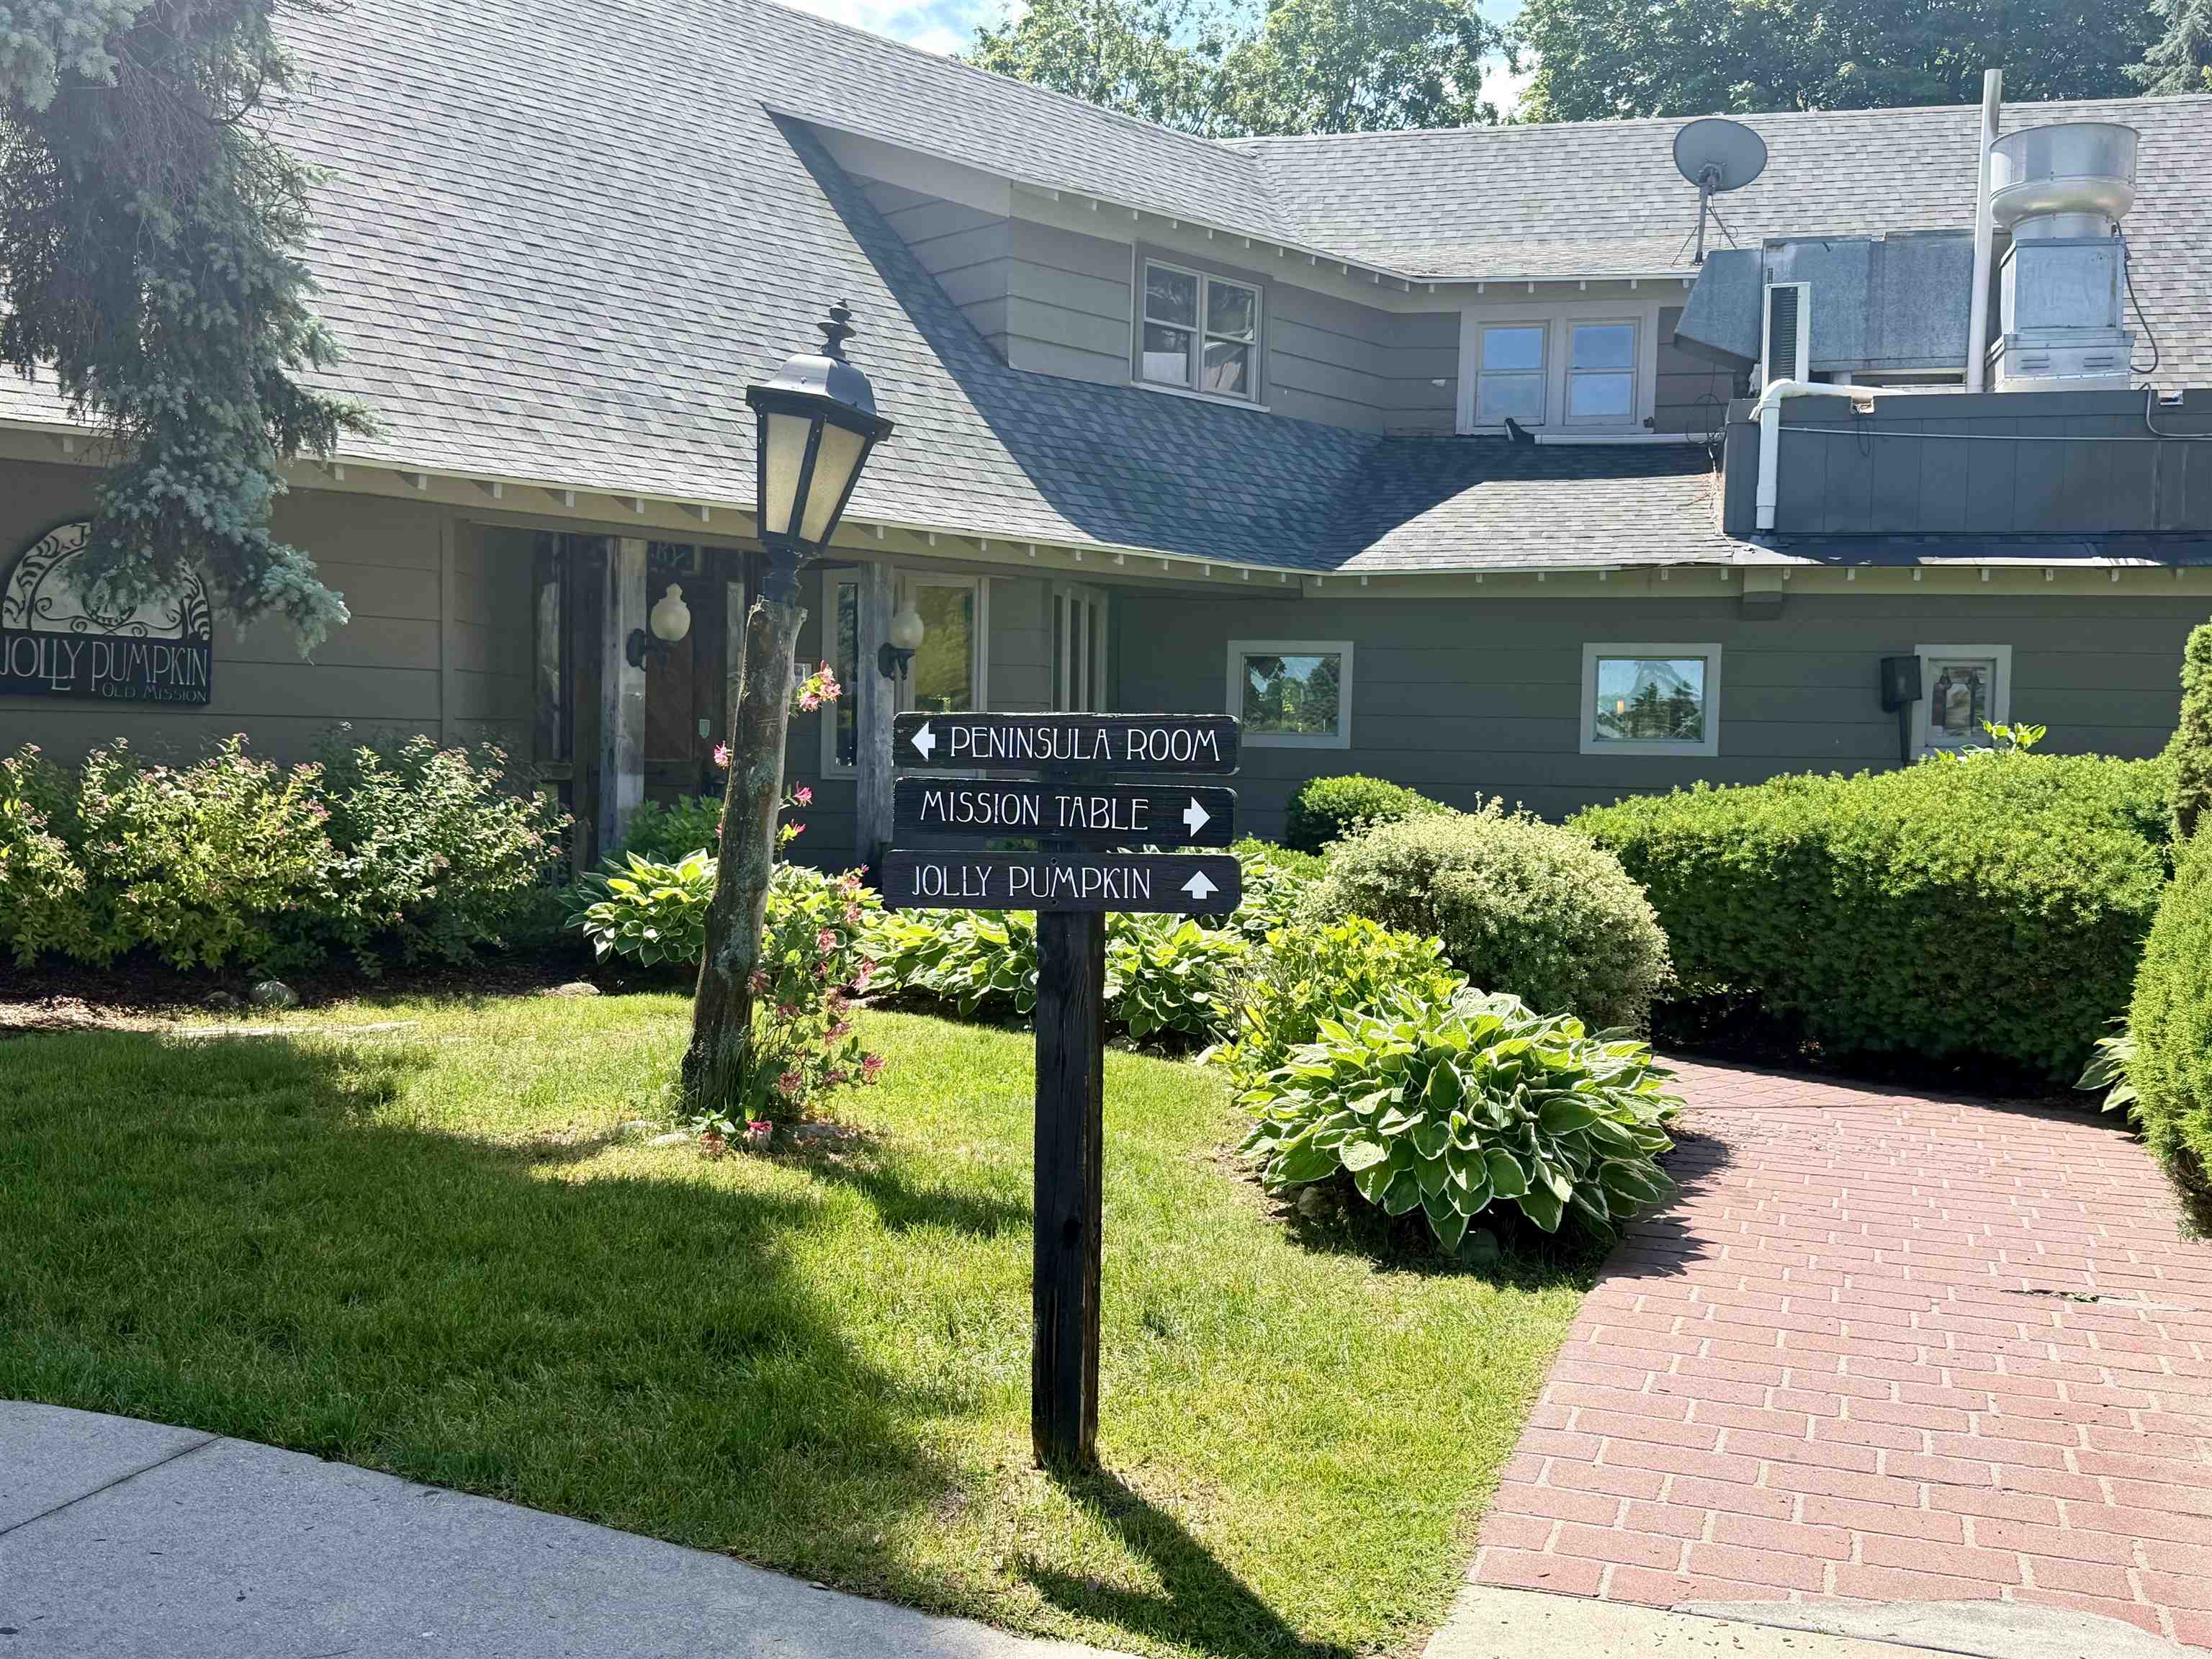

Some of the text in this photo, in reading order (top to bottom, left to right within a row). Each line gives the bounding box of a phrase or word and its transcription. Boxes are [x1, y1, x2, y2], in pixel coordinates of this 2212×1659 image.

[0, 637, 207, 691] JOLLY PUMPKIN
[102, 683, 207, 703] OLD MISSION
[950, 727, 1220, 761] PENINSULA ROOM
[920, 791, 1149, 830] MISSION TABLE
[912, 865, 1150, 899] JOLLY PUMPKIN
